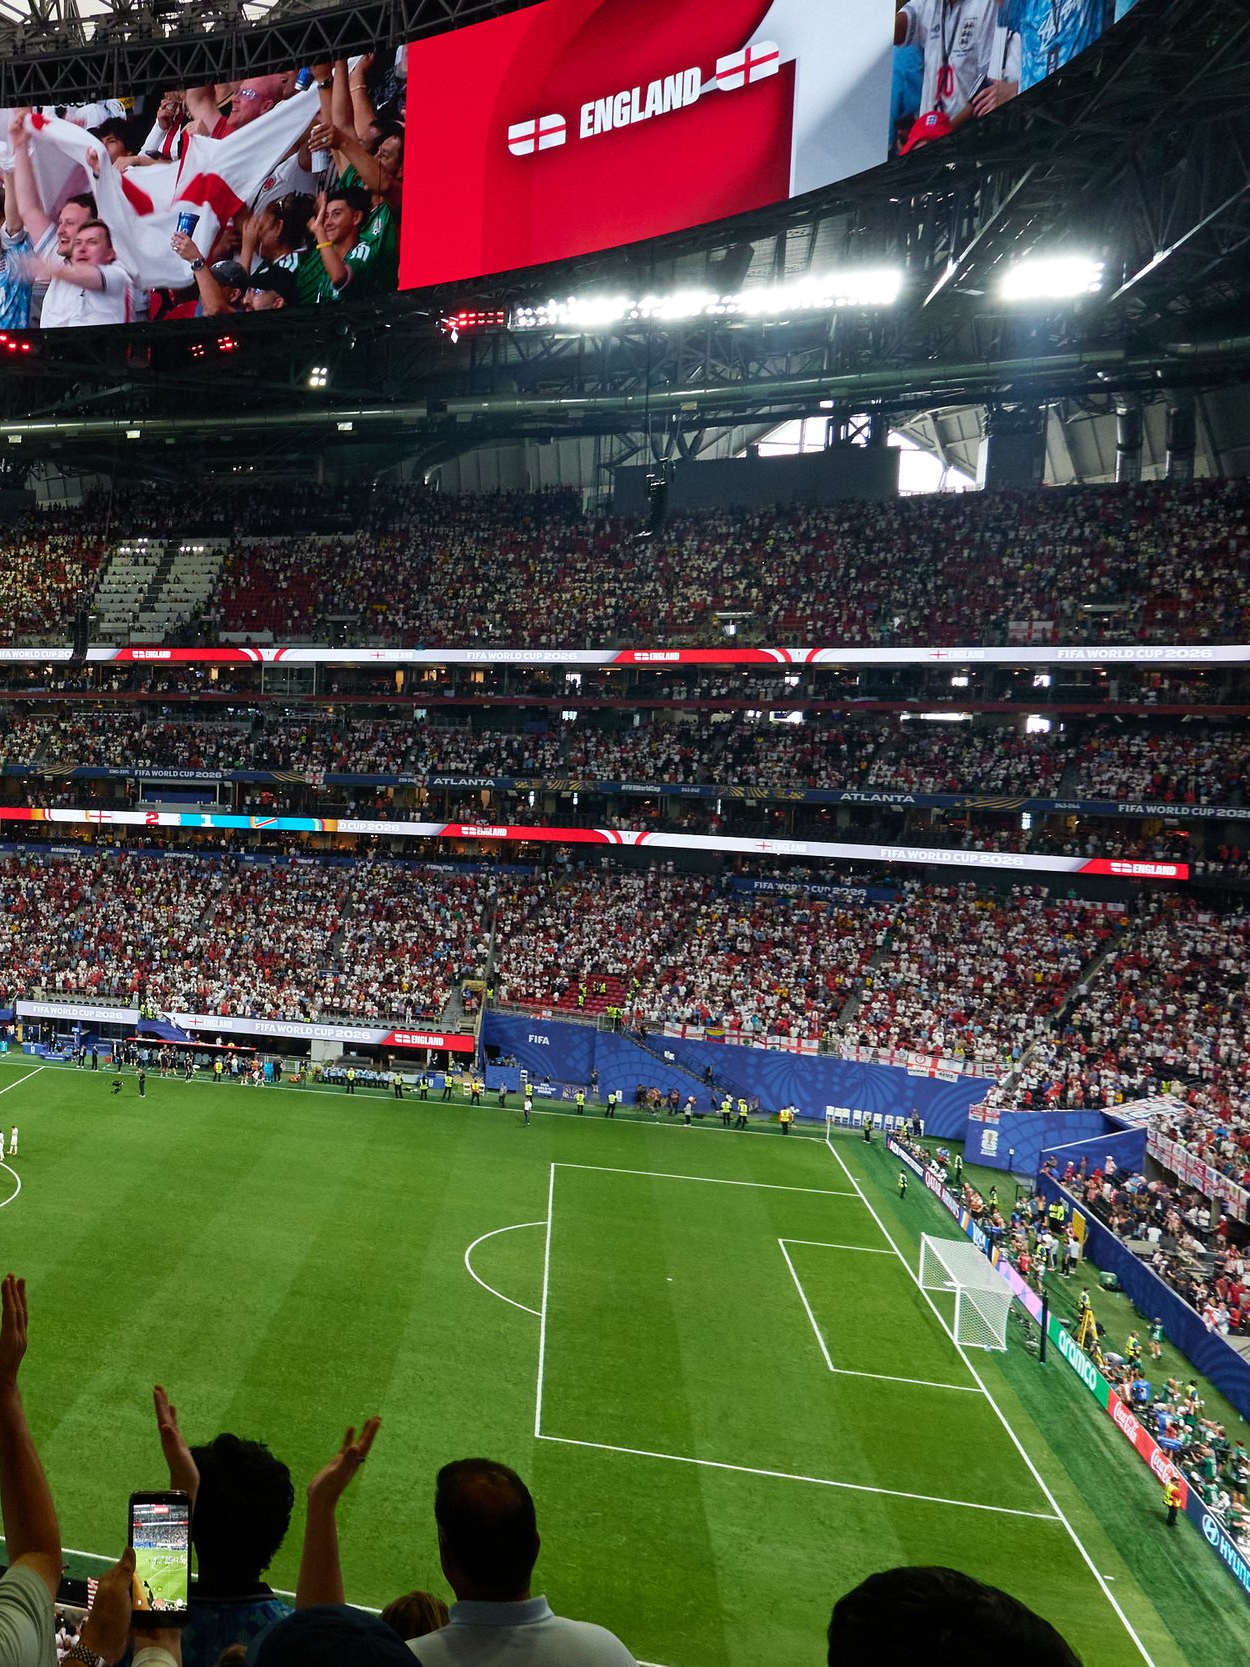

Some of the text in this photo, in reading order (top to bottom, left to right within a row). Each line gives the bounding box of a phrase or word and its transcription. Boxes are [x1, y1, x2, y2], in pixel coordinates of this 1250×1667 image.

[579, 67, 701, 139] ENGLAND
[42, 650, 57, 658] CUP
[524, 652, 542, 660] CUP
[544, 652, 577, 660] 2026
[650, 652, 680, 661] ENGLAND
[1058, 649, 1213, 660] FIFA WORLD CUP 2026
[433, 778, 495, 786] ATLANTA
[840, 793, 915, 803] ATLANTA
[1118, 805, 1146, 813] FIFA
[1147, 806, 1190, 815] WORLD
[1192, 807, 1214, 816] CUP
[146, 812, 159, 825] 2
[201, 814, 214, 827] 1
[347, 823, 366, 831] CUP
[367, 823, 400, 832] 2026
[477, 827, 507, 836] ENGLAND
[773, 842, 806, 852] ENGLAND
[881, 850, 1024, 865] FIFA WORLD CUP 2026
[1133, 864, 1176, 876] ENGLAND
[754, 882, 774, 890] FIFA
[33, 1006, 122, 1019] FIFA WORLD CUP 2026
[255, 1023, 370, 1039] FIFA WORLD CUP 2026
[411, 1034, 444, 1046] ENGLAND
[528, 1034, 550, 1045] FIFA
[1058, 1336, 1097, 1390] aramco
[1113, 1401, 1139, 1443] Coca-Cola
